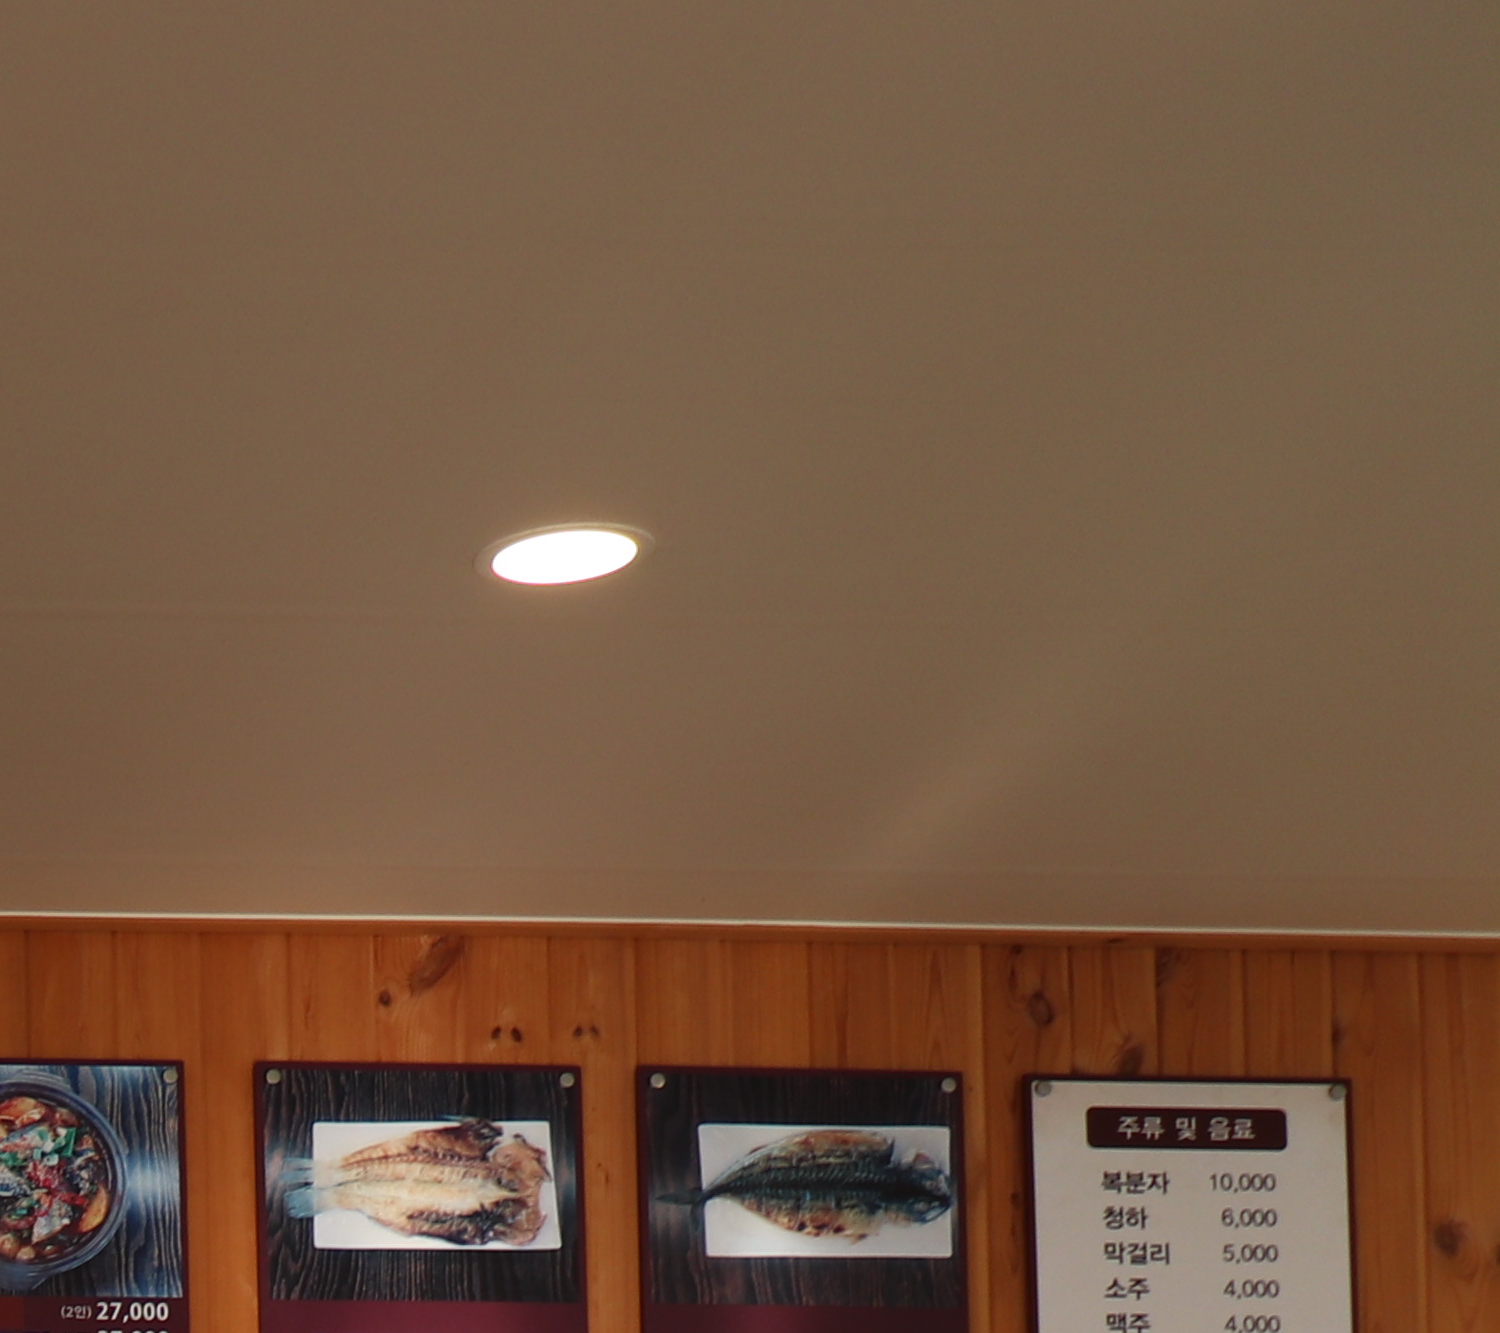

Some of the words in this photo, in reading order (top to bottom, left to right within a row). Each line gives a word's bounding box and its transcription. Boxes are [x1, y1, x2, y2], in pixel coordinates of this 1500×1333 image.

[1117, 1116, 1165, 1139] 주류
[1175, 1116, 1197, 1141] 및
[1208, 1116, 1256, 1141] 음료
[1101, 1170, 1170, 1194] 복분자
[1209, 1173, 1276, 1194] 10,000
[1103, 1206, 1147, 1230] 청하
[1221, 1208, 1277, 1229] 6,000
[1103, 1242, 1171, 1266] 막걸리
[1222, 1244, 1279, 1265] 5,000
[1104, 1278, 1150, 1300] 소주
[1223, 1280, 1280, 1300] 4,000
[60, 1304, 93, 1321] (2인)
[96, 1302, 170, 1325] 27,000
